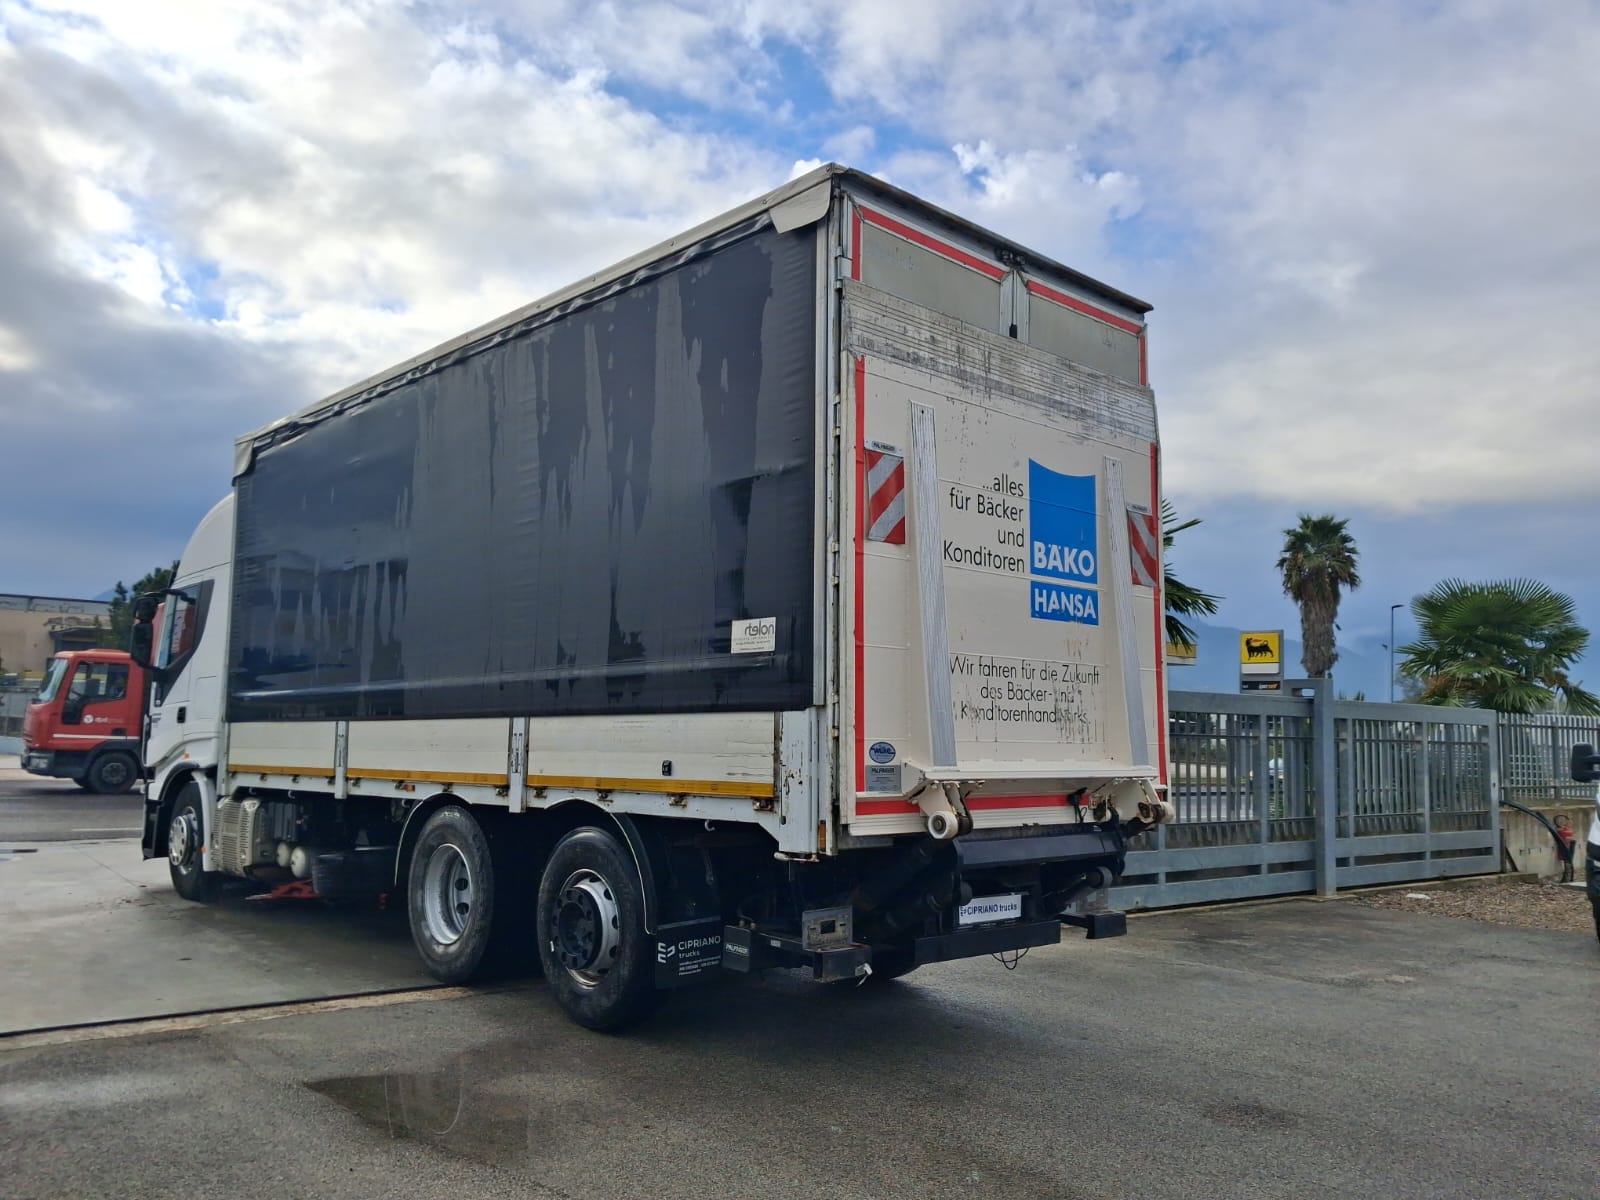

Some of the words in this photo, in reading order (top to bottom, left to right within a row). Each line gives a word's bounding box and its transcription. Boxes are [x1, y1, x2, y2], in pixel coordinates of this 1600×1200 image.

[949, 487, 971, 511] für
[977, 494, 1024, 522] Bäcker
[997, 528, 1025, 548] und
[943, 540, 1025, 573] Konditoren
[1033, 541, 1095, 577] BÄKO
[1034, 588, 1097, 619] HANSA
[950, 655, 975, 676] Wir
[979, 655, 1017, 679] fahren
[1021, 659, 1036, 680] für
[1040, 661, 1058, 681] die
[1062, 664, 1100, 686] Zukunft
[1007, 681, 1053, 702] Bäcker-
[967, 904, 998, 915] CIPRIANO
[999, 902, 1017, 912] trucks
[678, 936, 721, 950] CIPRIANO
[678, 950, 700, 959] trucks
